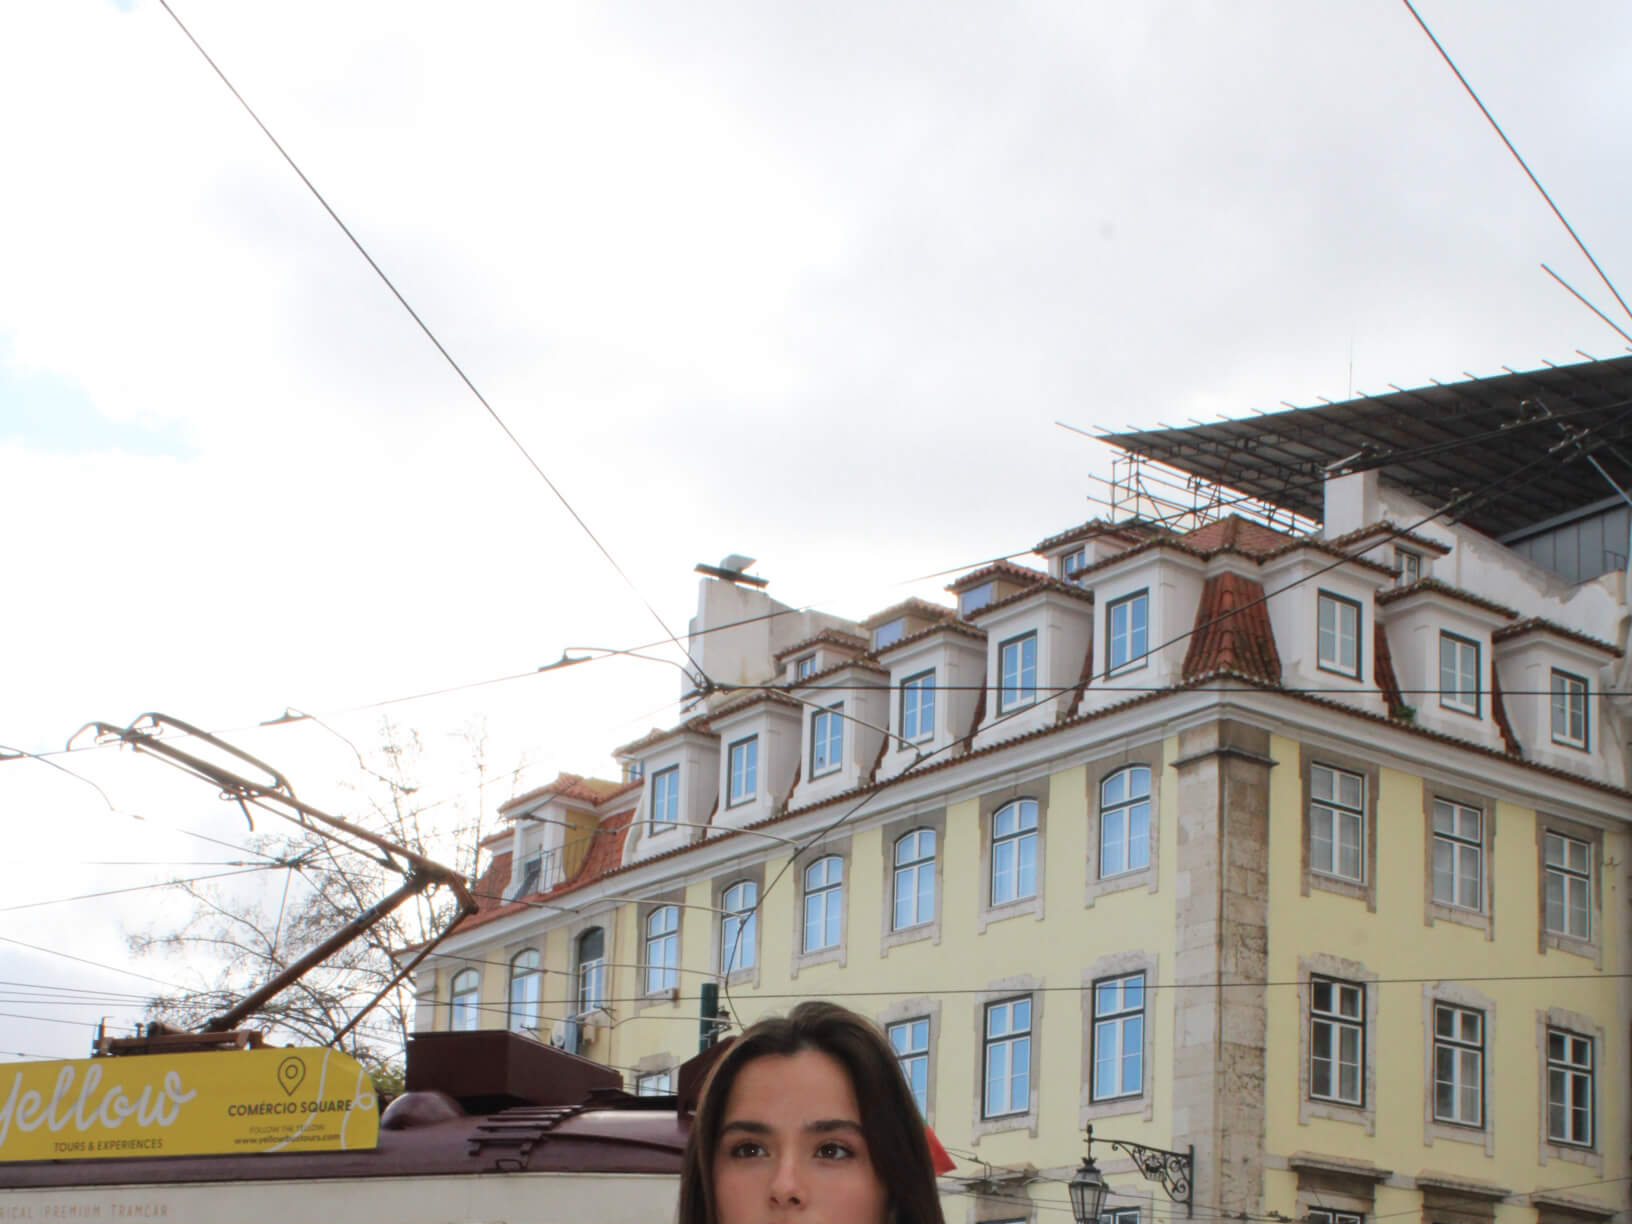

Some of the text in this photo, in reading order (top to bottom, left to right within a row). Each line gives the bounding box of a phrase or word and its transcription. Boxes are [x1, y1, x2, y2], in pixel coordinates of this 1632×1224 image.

[300, 1099, 353, 1113] SQUARE
[54, 1138, 163, 1152] TOURS & EXPERIENCES
[45, 1205, 101, 1217] PREMIUM
[112, 1203, 168, 1217] TRAMCAR
